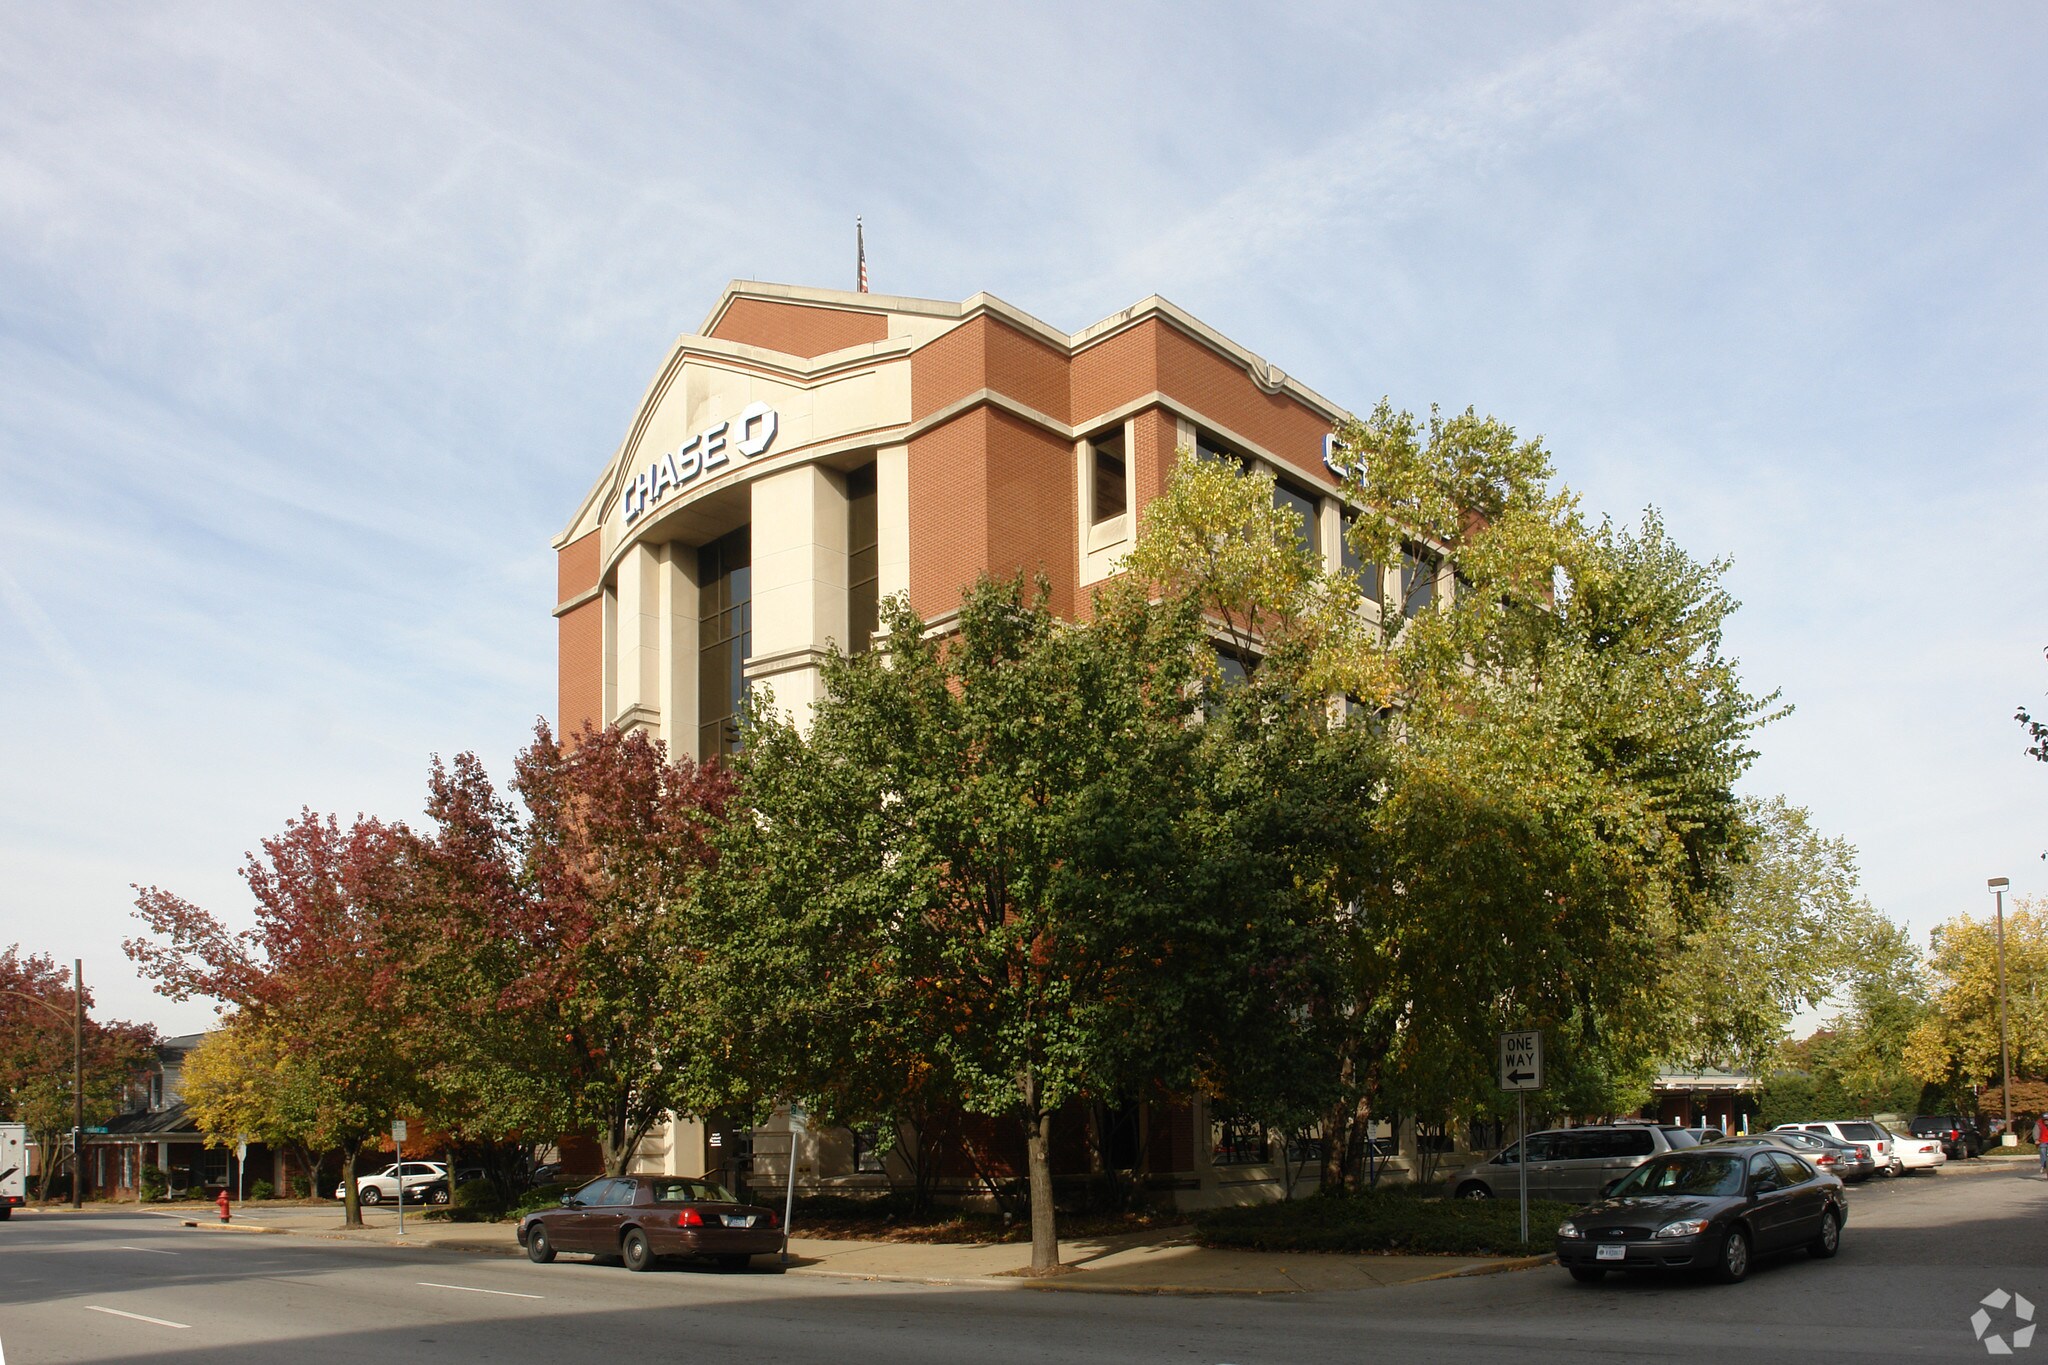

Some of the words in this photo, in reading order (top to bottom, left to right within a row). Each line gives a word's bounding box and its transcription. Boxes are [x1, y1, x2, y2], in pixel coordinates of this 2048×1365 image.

[621, 421, 729, 526] CHASE
[1507, 1037, 1533, 1051] ONE
[1505, 1053, 1535, 1068] WAY
